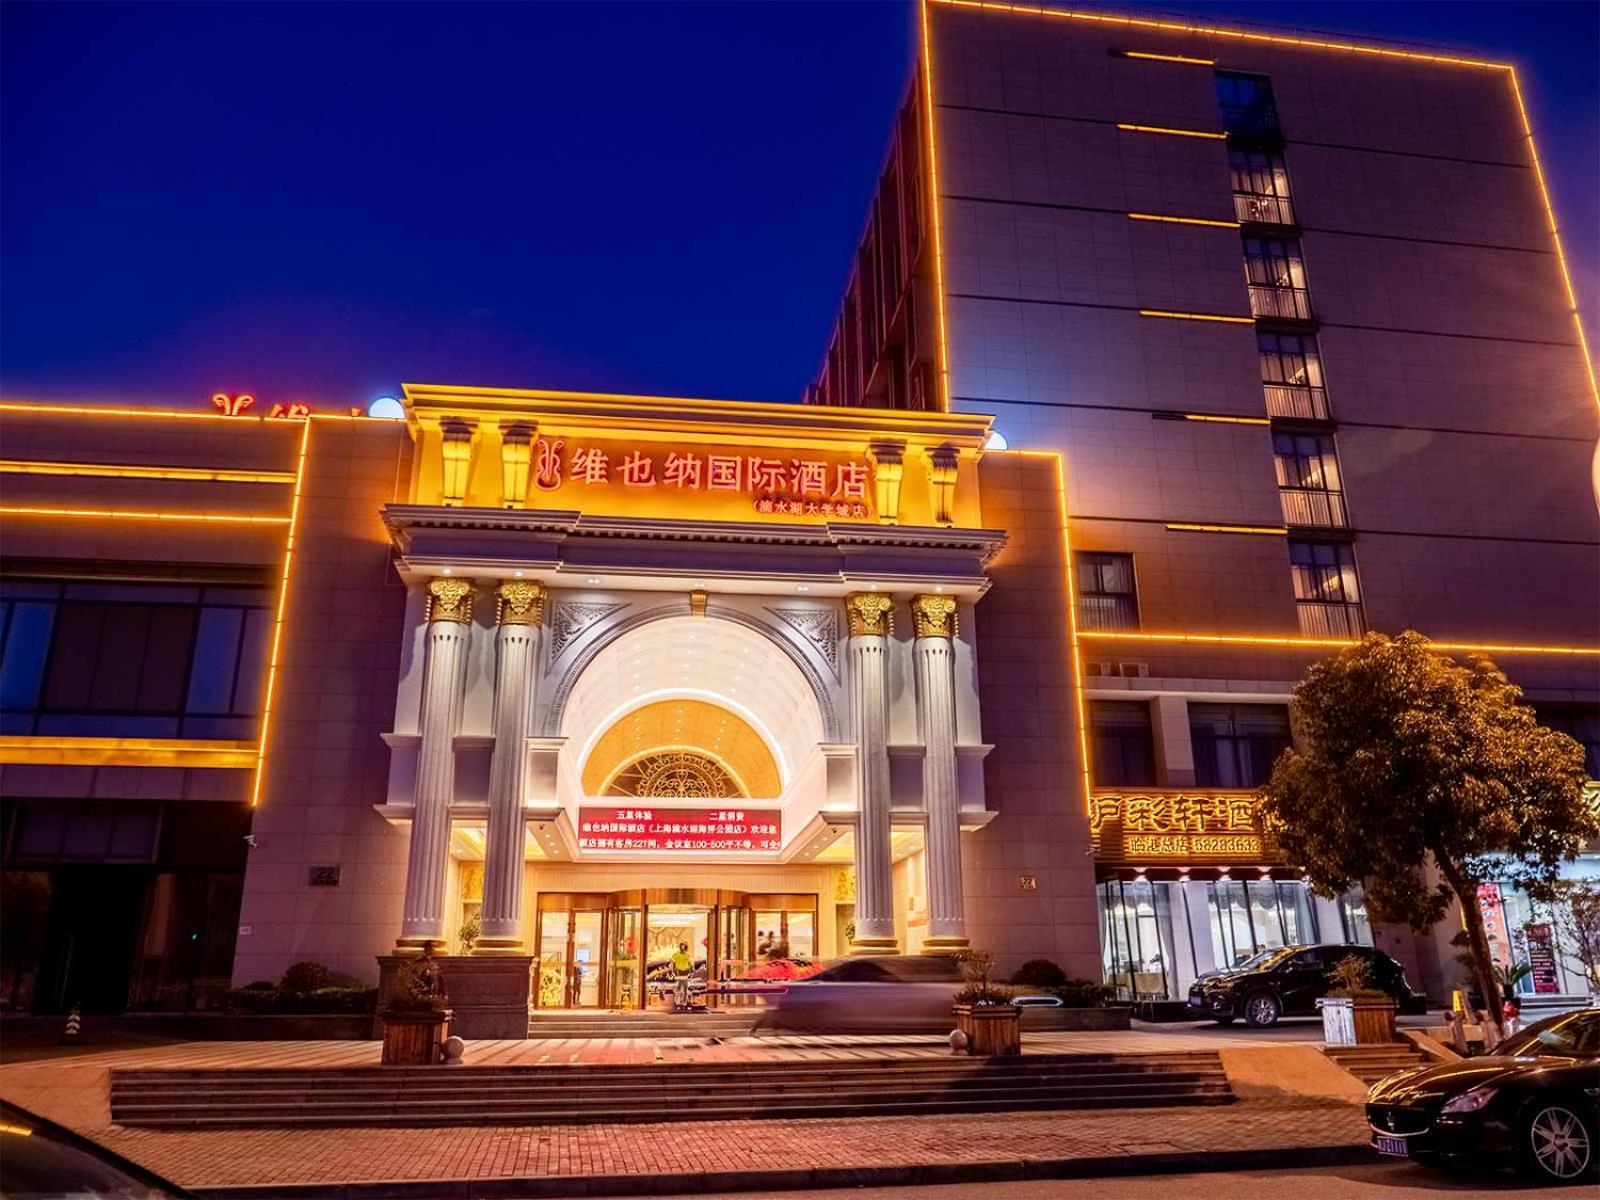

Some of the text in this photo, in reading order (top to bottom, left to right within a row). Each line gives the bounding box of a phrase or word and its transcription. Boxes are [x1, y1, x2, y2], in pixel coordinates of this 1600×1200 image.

[570, 447, 869, 498] 维也纳国际酒店
